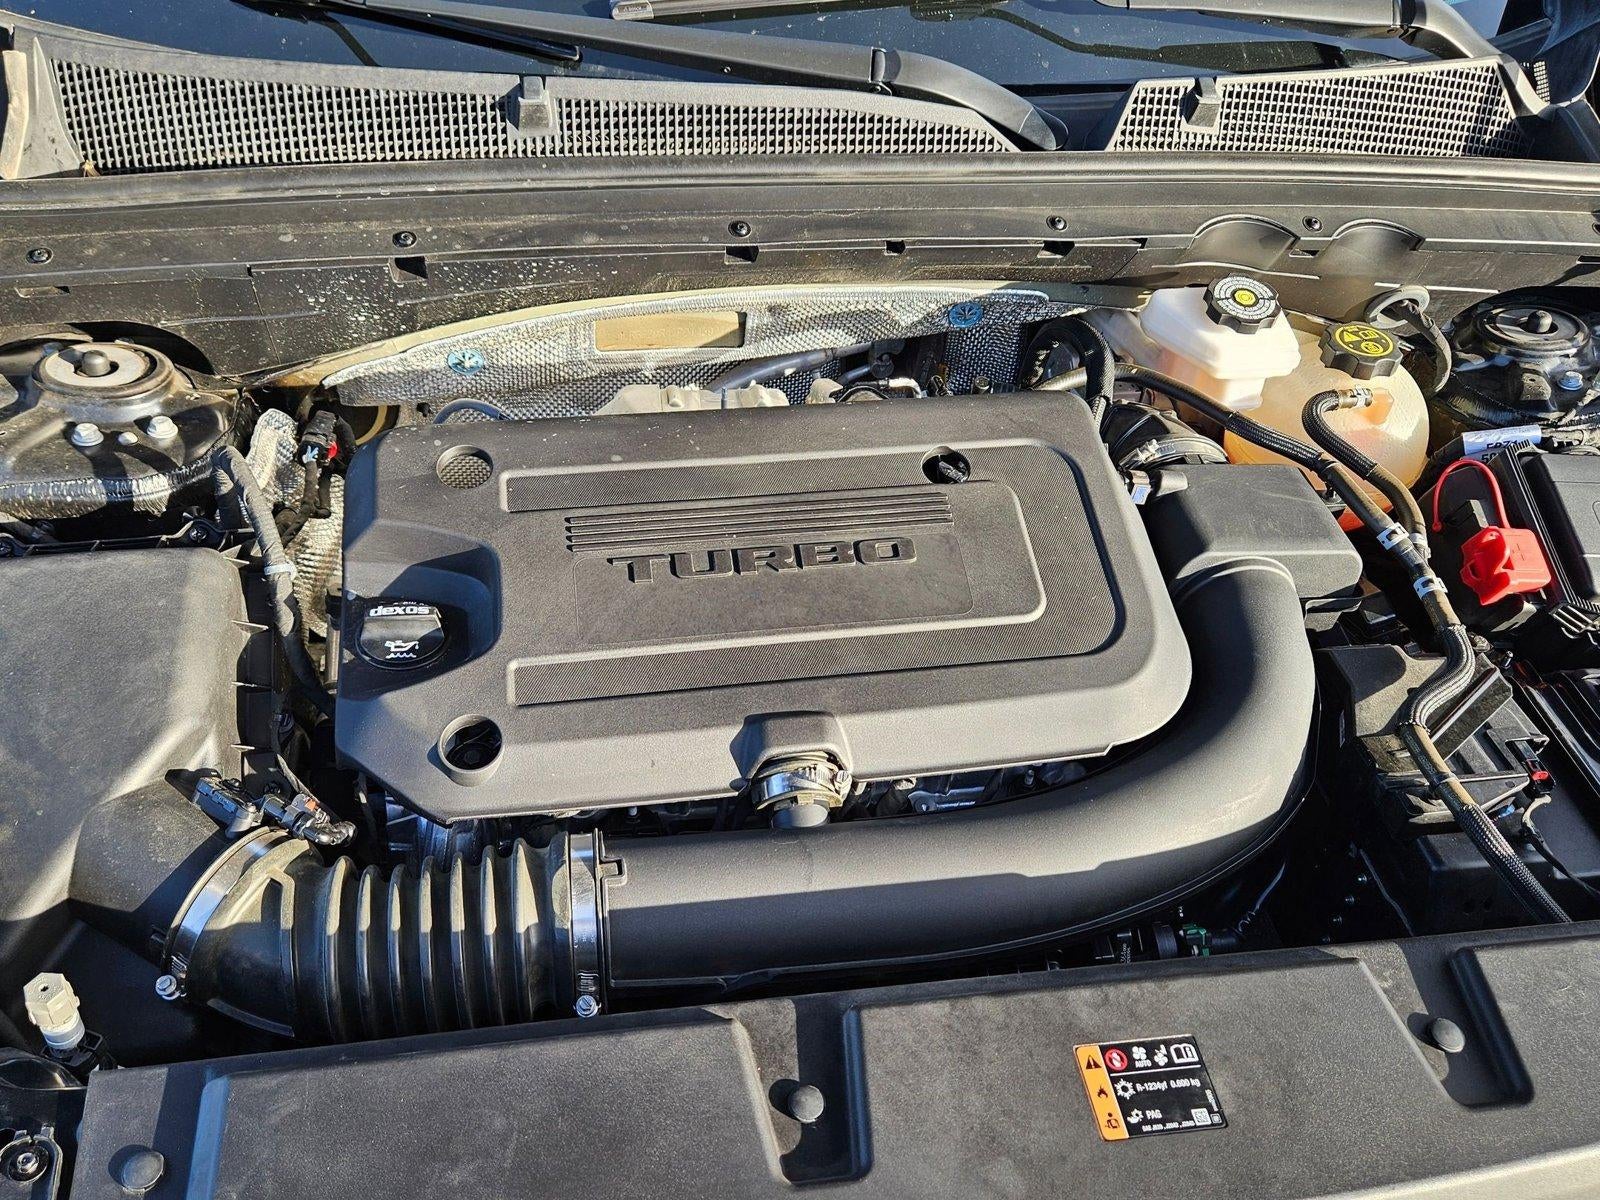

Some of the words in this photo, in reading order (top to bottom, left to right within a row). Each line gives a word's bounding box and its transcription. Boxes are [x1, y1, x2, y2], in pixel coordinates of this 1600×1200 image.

[607, 537, 917, 583] TURBO
[369, 605, 430, 616] dexos
[1146, 1110, 1162, 1119] PAG
